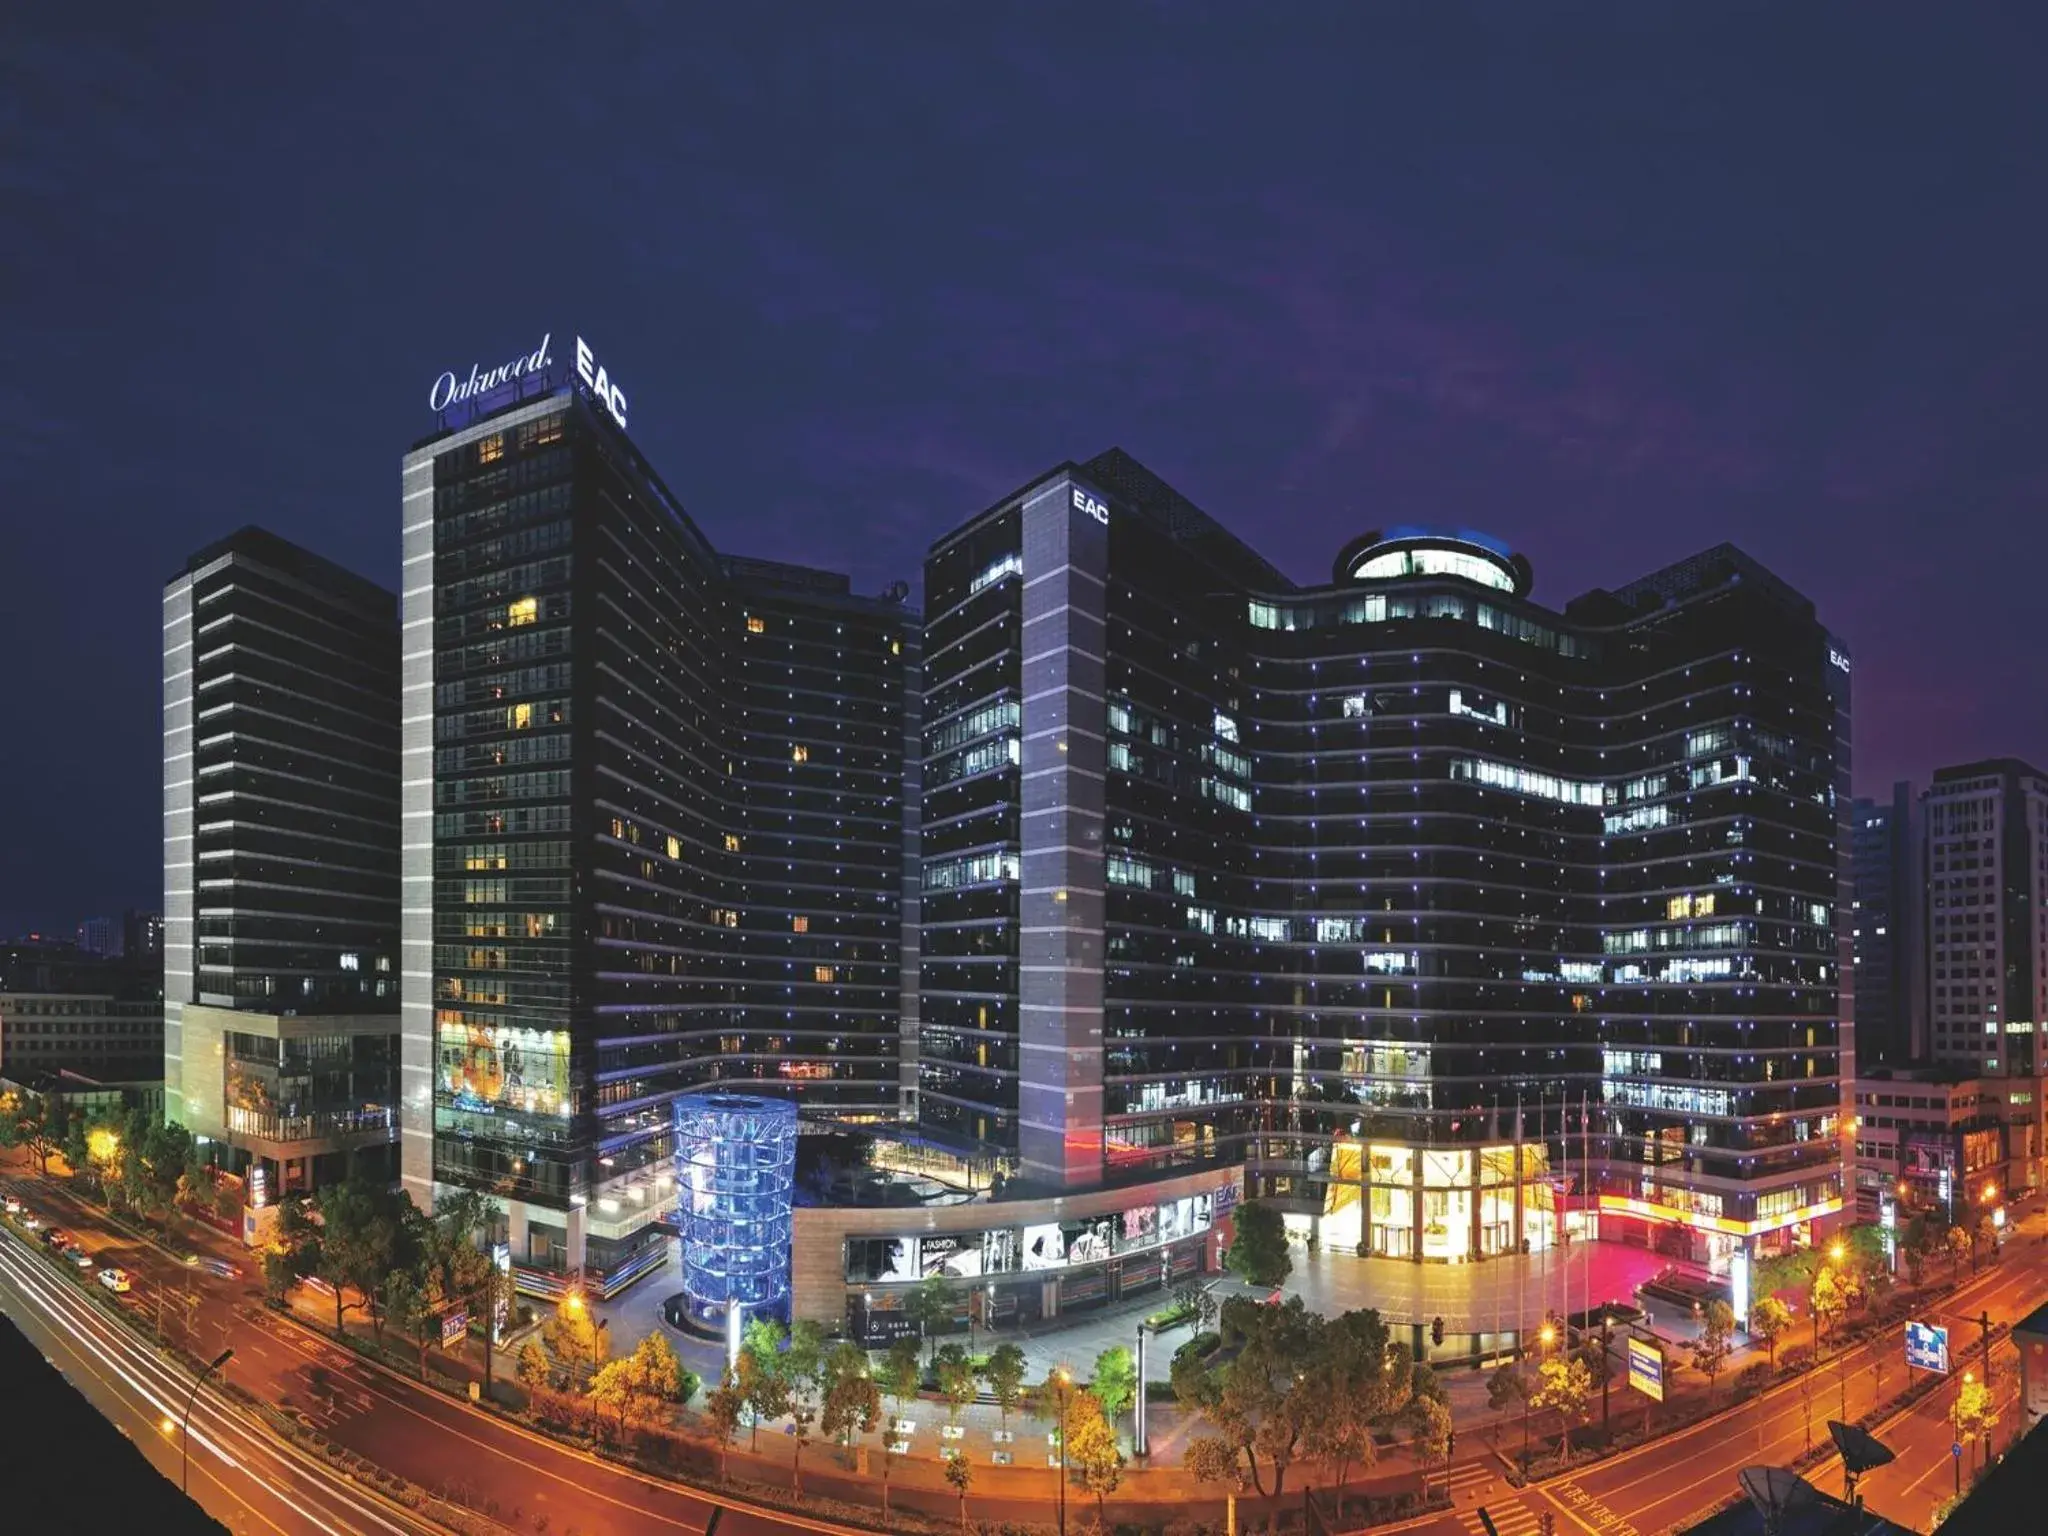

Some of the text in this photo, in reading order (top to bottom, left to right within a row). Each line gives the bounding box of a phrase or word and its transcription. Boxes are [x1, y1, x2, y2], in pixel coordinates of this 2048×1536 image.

[577, 335, 627, 428] EAC
[1073, 488, 1109, 525] EAC
[1830, 649, 1850, 673] EAC
